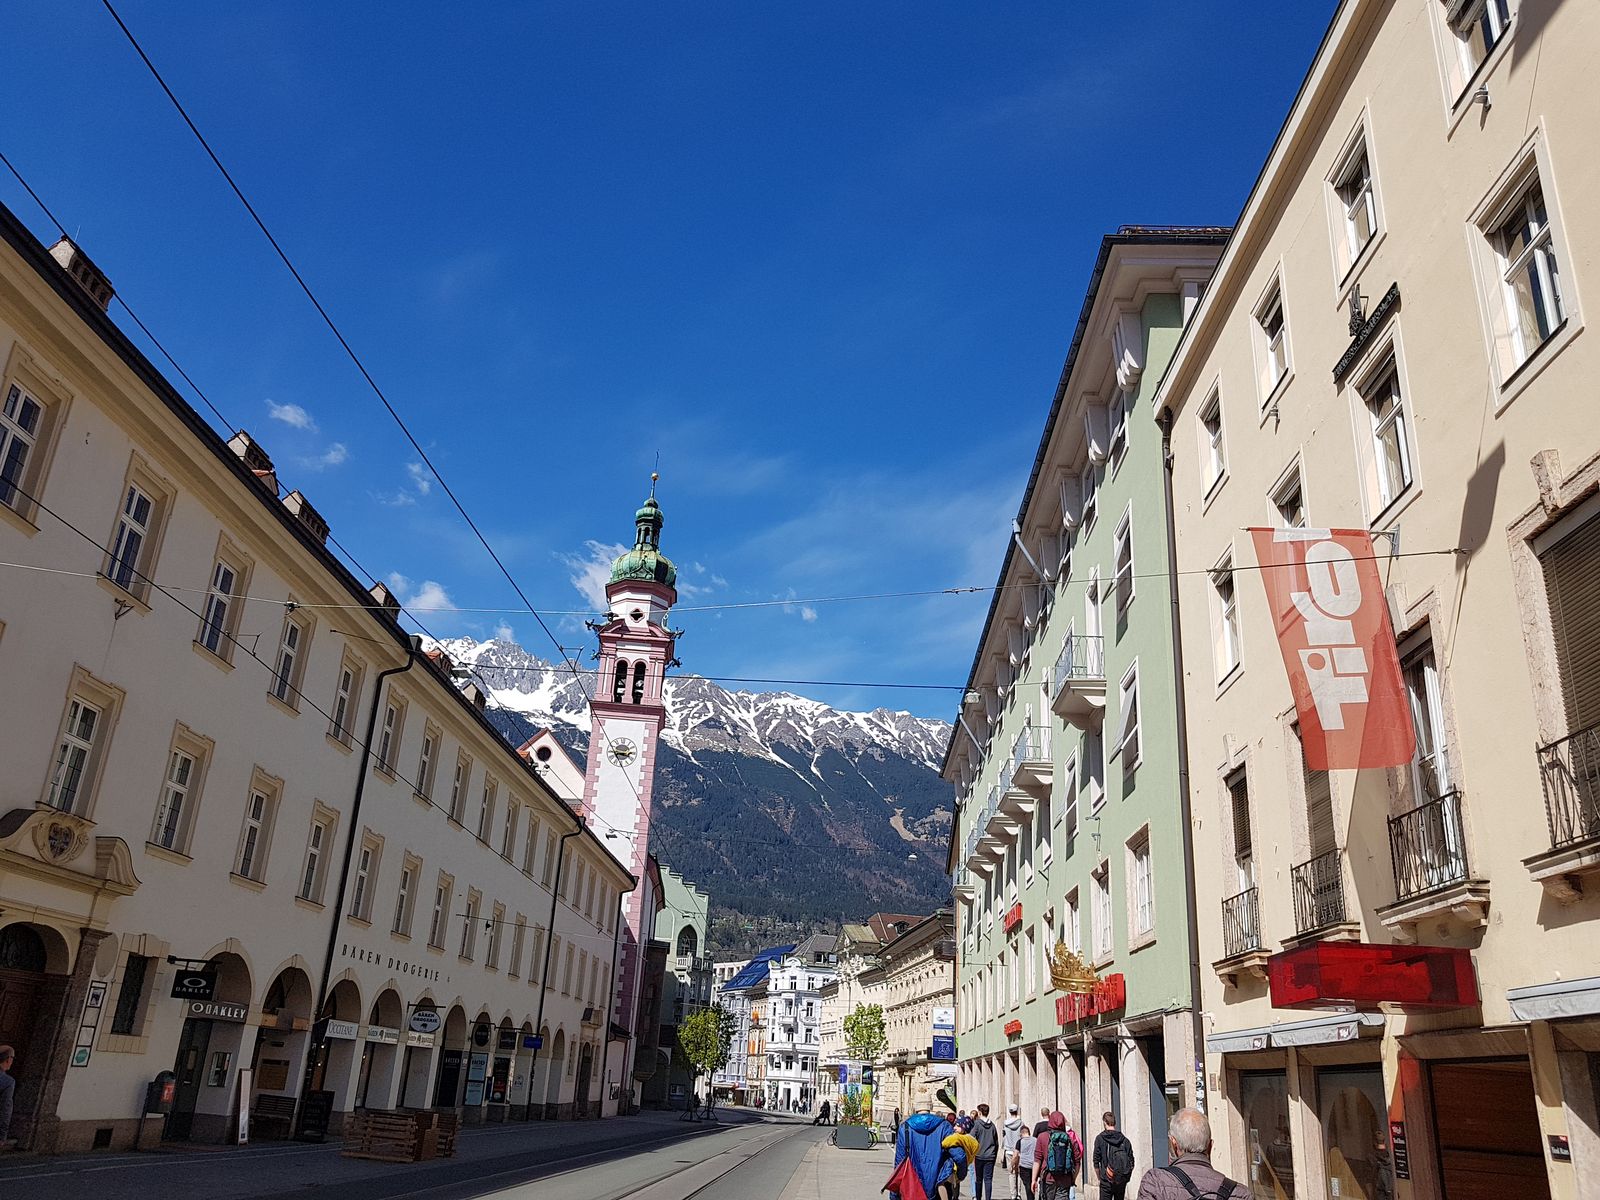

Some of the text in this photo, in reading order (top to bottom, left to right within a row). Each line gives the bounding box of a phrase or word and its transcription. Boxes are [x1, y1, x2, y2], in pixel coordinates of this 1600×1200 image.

[342, 944, 439, 981] BÄREN DROGERIE
[175, 986, 211, 994] OAKLEY
[205, 1004, 246, 1019] OAKLEY
